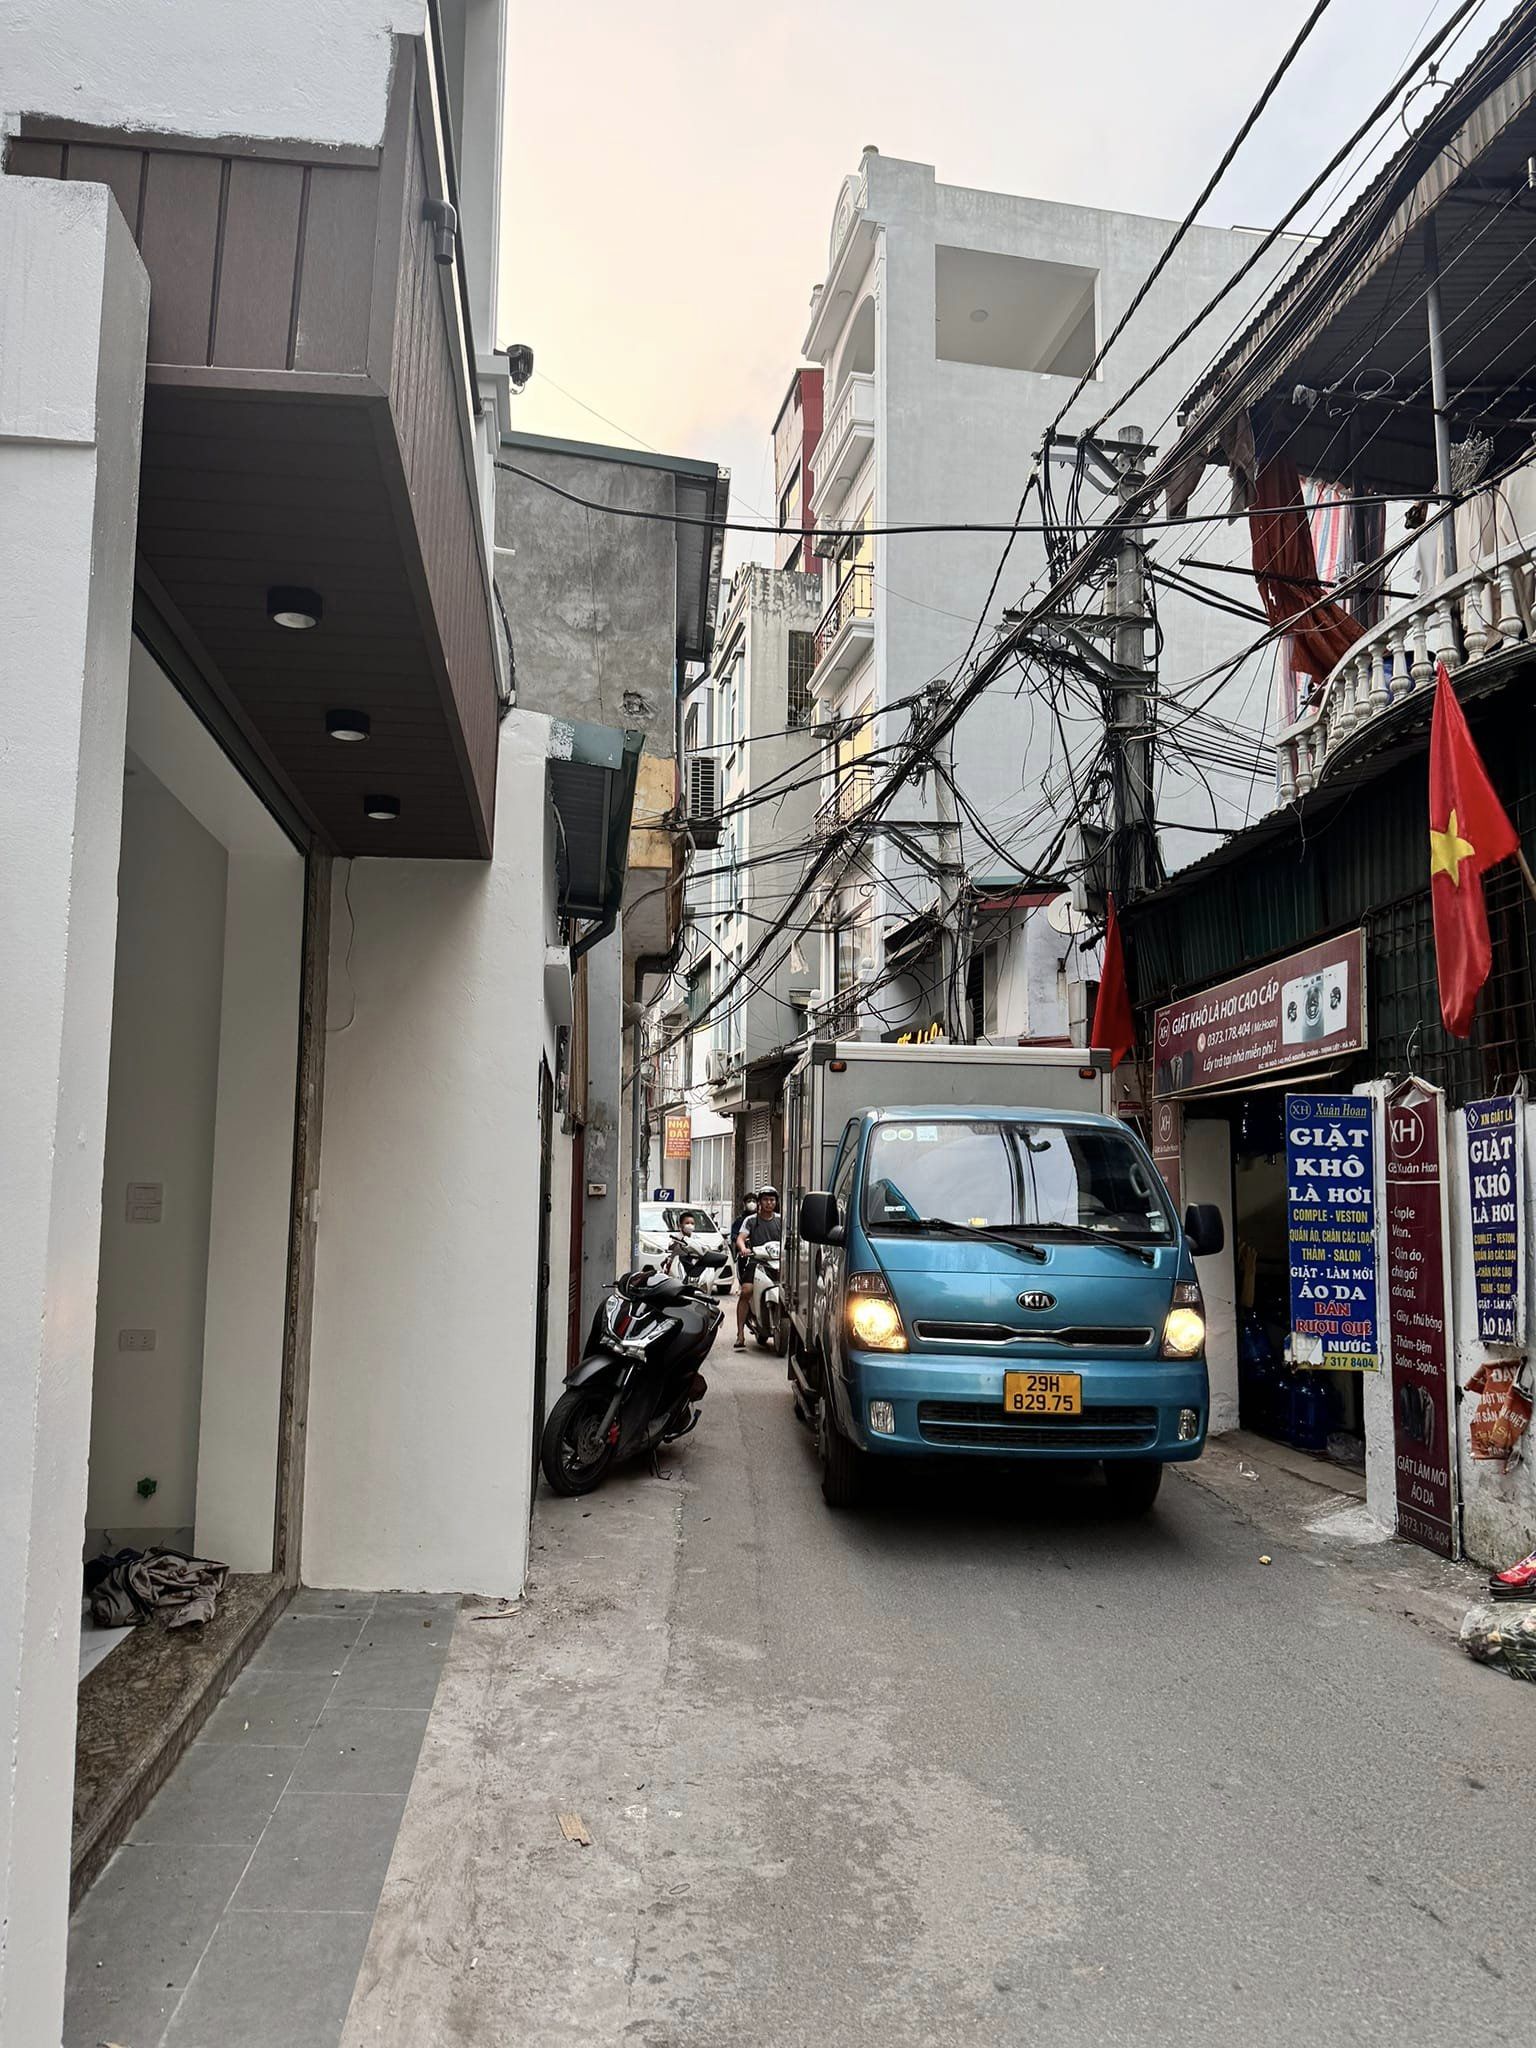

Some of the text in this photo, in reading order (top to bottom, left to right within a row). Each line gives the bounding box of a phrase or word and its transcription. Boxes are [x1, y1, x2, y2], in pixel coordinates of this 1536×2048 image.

[1190, 1004, 1208, 1030] KHÔ
[1208, 1000, 1219, 1023] LÀ
[1220, 996, 1237, 1019] HƠI
[1238, 989, 1257, 1013] CAO
[1259, 977, 1279, 1005] CẤP
[1160, 1026, 1168, 1039] XH
[1207, 1021, 1250, 1047] 0373.178.404
[1292, 1103, 1367, 1116] XH Xuân Hoan
[1290, 1123, 1369, 1152] GIẶT
[1390, 1118, 1415, 1143] XH
[1470, 1131, 1512, 1166] GIẶT
[1295, 1154, 1365, 1178] KHÔ
[1474, 1165, 1511, 1199] KHÔ
[1289, 1183, 1372, 1204] LÀ HƠI
[1293, 1208, 1368, 1223] COMPLE VESTON
[1472, 1201, 1515, 1224] LÀ HƠI
[1333, 1249, 1361, 1262] SALON
[1290, 1264, 1318, 1280] GIẶT
[1326, 1265, 1349, 1279] LÀM
[1298, 1281, 1367, 1300] ÁO DA
[1024, 1295, 1050, 1307] KIA
[1314, 1300, 1351, 1316] BÁN
[1482, 1312, 1496, 1335] ÁO
[1328, 1339, 1371, 1353] NƯỚC
[1330, 1356, 1348, 1367] 317
[1351, 1357, 1374, 1368] 8404
[1395, 1353, 1412, 1368] Salon
[1027, 1375, 1059, 1393] 29H
[1013, 1393, 1073, 1411] 829.75
[1414, 1459, 1430, 1480] LÀM
[1411, 1481, 1435, 1507] ÁO DA
[1400, 1513, 1449, 1548] 0373.178.404
